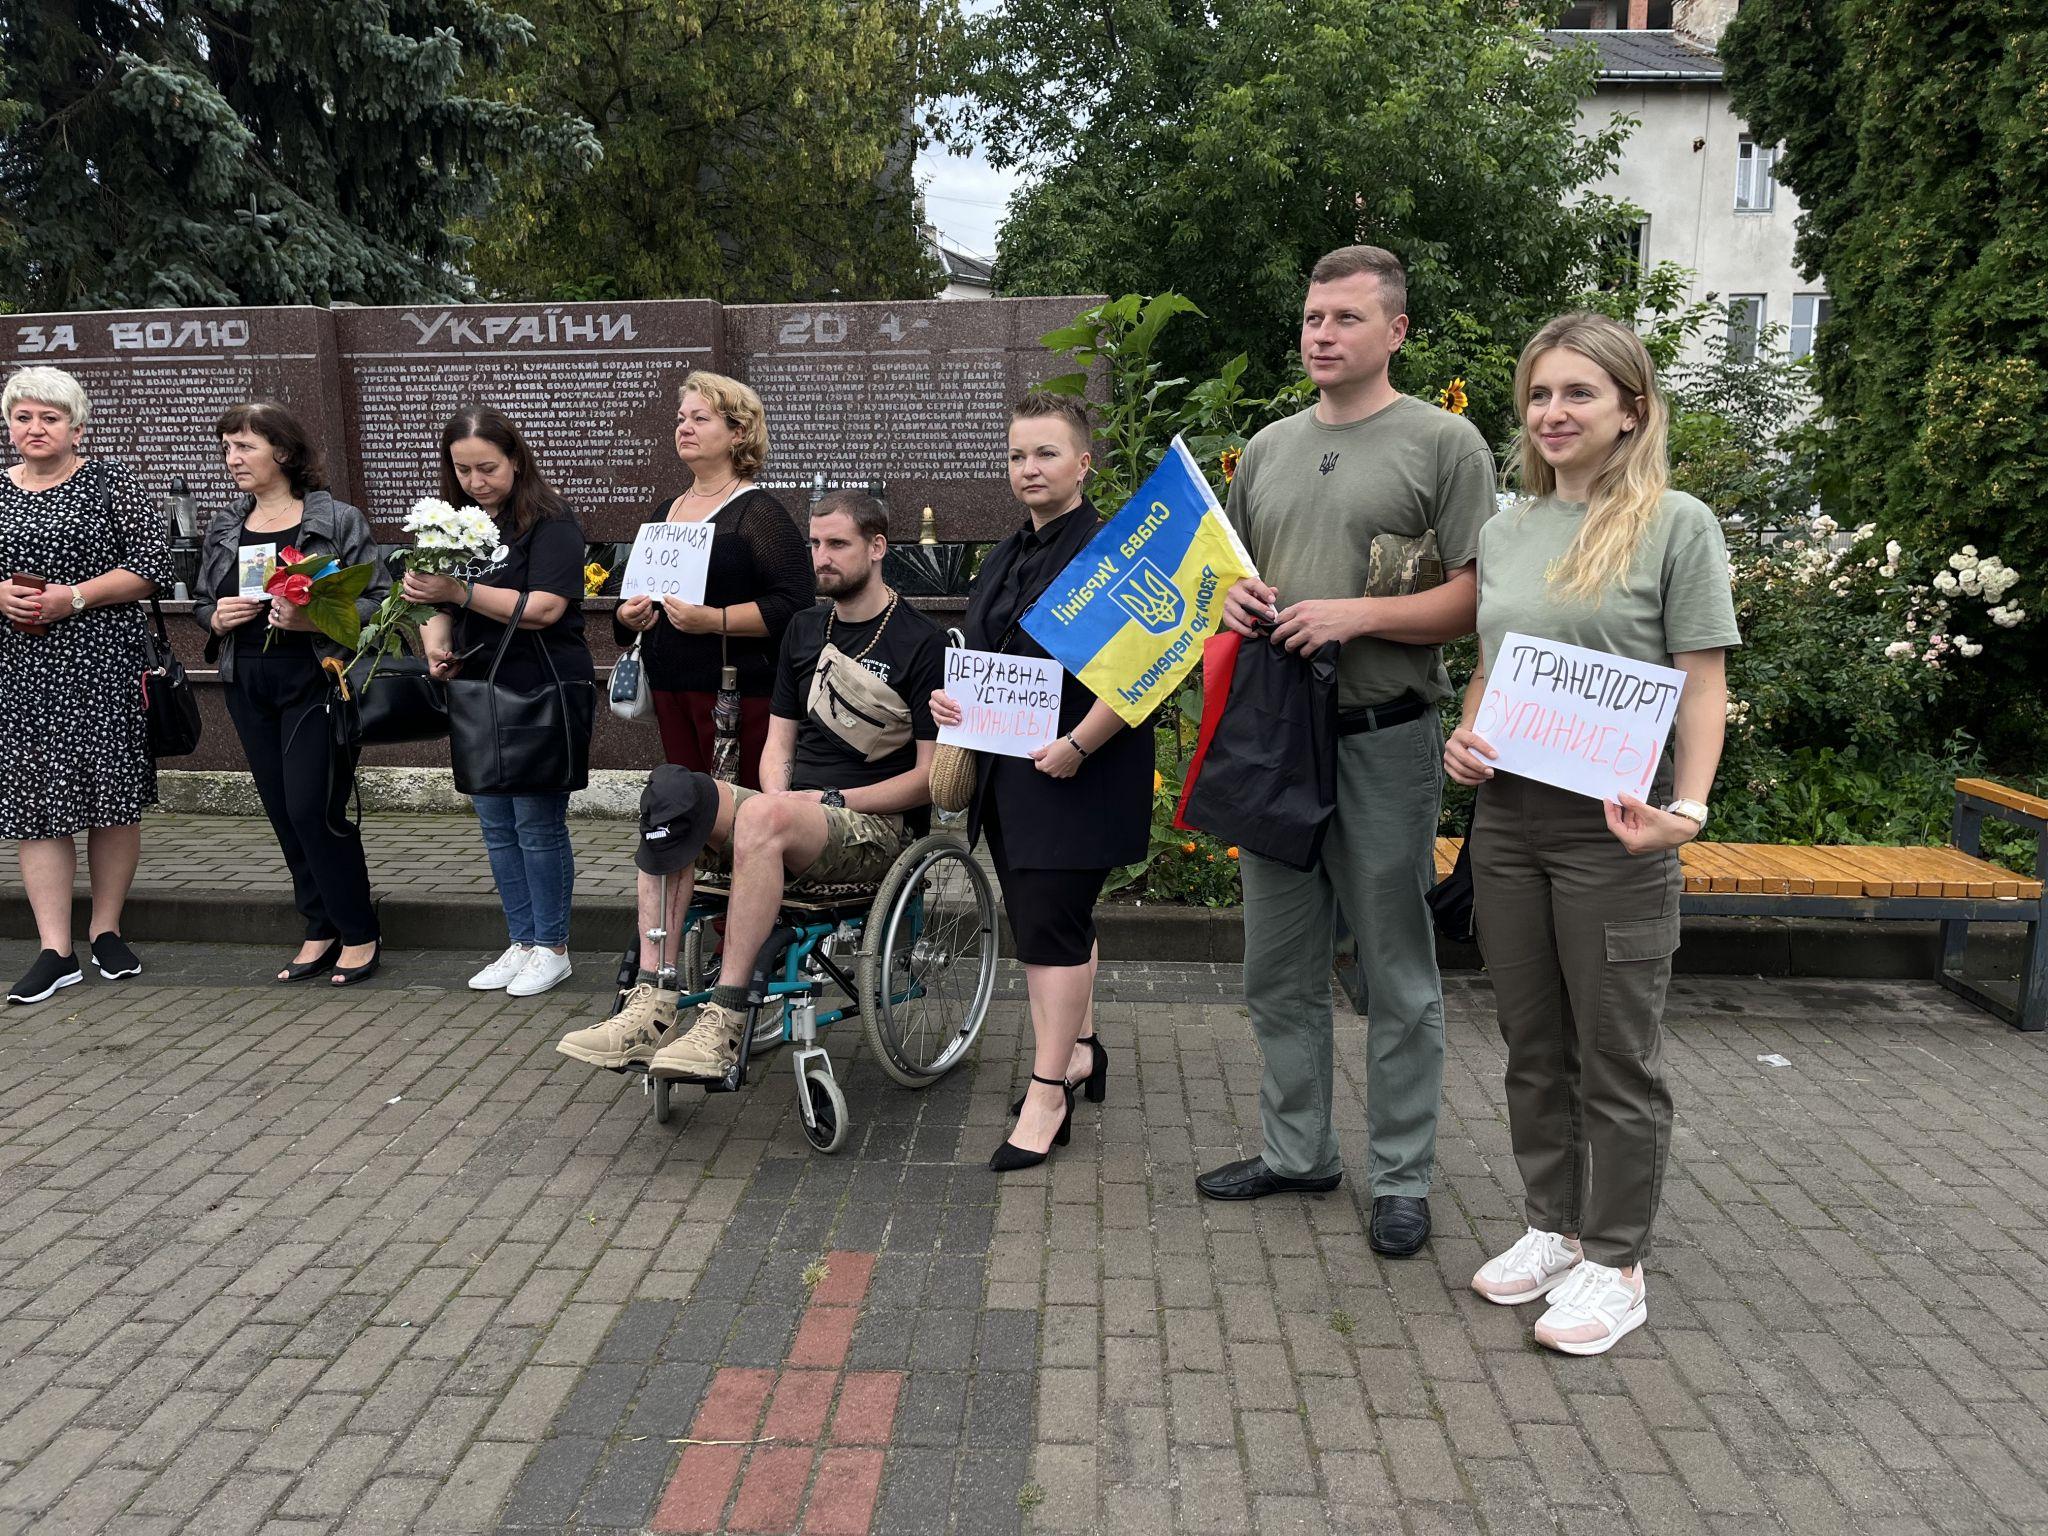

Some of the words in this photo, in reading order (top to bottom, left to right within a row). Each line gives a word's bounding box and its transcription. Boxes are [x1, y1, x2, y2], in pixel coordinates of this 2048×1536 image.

[401, 308, 639, 345] УКРАЇНИ
[779, 312, 906, 345] 204
[16, 324, 79, 353] ЗА
[107, 319, 250, 350] ВОЛЮ
[475, 363, 501, 372] (2015
[523, 361, 599, 370] КУРМАНСЬКИЙ
[602, 361, 643, 370] БОГДАН
[646, 360, 672, 369] (2015
[675, 360, 690, 368] Р.)
[551, 372, 613, 381] ВОЛОДИМИР
[616, 371, 642, 380] (2015
[796, 374, 839, 382] СТЕПАН
[146, 377, 207, 386] ВОЛОДИМИР
[406, 384, 464, 393] ОЛЕКСАНДР
[468, 383, 494, 392] (2016
[515, 381, 544, 390] ВОВК
[547, 382, 609, 391] ВОЛОДИМИР
[612, 380, 639, 389] (2016
[186, 386, 247, 395] ВОЛОДИМИР
[800, 384, 864, 393] ВОЛОДИМИР
[406, 394, 428, 402] ІГОР
[554, 392, 615, 400] РОСТИСЛАВ
[618, 390, 645, 399] (2016
[875, 393, 917, 401] МАРЧУК
[361, 404, 397, 412] ОВАЛЬ
[551, 399, 599, 408] МИХАЙЛО
[602, 400, 629, 409] (2016
[926, 400, 963, 409] СЕРГІЙ
[558, 409, 587, 418] ЮРІЙ
[589, 409, 616, 418] (2016
[892, 412, 962, 422] ЛЕДОВСЬКИЙ
[155, 416, 188, 424] РИМАР
[142, 425, 180, 433] ЧУХАСЬ
[403, 423, 426, 431] ІГОР
[525, 420, 567, 428] МИКОЛА
[569, 420, 597, 428] (2016
[548, 430, 582, 438] БОРИС
[588, 429, 614, 438] (2016
[781, 433, 842, 442] ОЛЕКСАНДР
[894, 432, 948, 440] СЕМЕНЮК
[951, 432, 1007, 440] ЛЮБОМИР
[396, 441, 433, 450] РУСЛАН
[549, 439, 611, 448] ВОЛОДИМИР
[614, 438, 641, 447] (2016
[891, 440, 952, 449] СЕЛЬСЬКИЙ
[145, 453, 203, 462] РОСТИСЛАВ
[361, 451, 418, 459] ШЕВЧЕНКО
[543, 449, 605, 458] ВОЛОДИМИР
[608, 448, 634, 457] (2016
[816, 452, 856, 460] РУСЛАН
[859, 451, 887, 460] (2019
[908, 451, 956, 460] СТЕЦЮК
[556, 458, 604, 467] МИХАЙЛО
[606, 458, 634, 467] (2016
[802, 460, 852, 470] МИХАЙЛО
[855, 461, 882, 470] (2019
[903, 461, 940, 470] СОБКО
[943, 460, 986, 469] ВІТАЛІЙ
[187, 472, 220, 480] ПЕТРО
[567, 477, 593, 486] (2017
[755, 480, 796, 489] СТОЙКО
[842, 481, 869, 489] (2018
[563, 487, 609, 495] ЯРОСЛАВ
[613, 486, 638, 495] (2017
[609, 495, 635, 504] (2018
[644, 523, 708, 550] ПЯТНИЦЯ
[645, 546, 680, 568] 9.08
[646, 576, 681, 595] 9.00
[948, 652, 1048, 686] ДЕРЖАВНА
[1512, 646, 1678, 724] ТРАНСПОРТ
[973, 683, 1060, 710] УСТАНОВО
[1478, 688, 1658, 793] ЗУПИНИСЬ!
